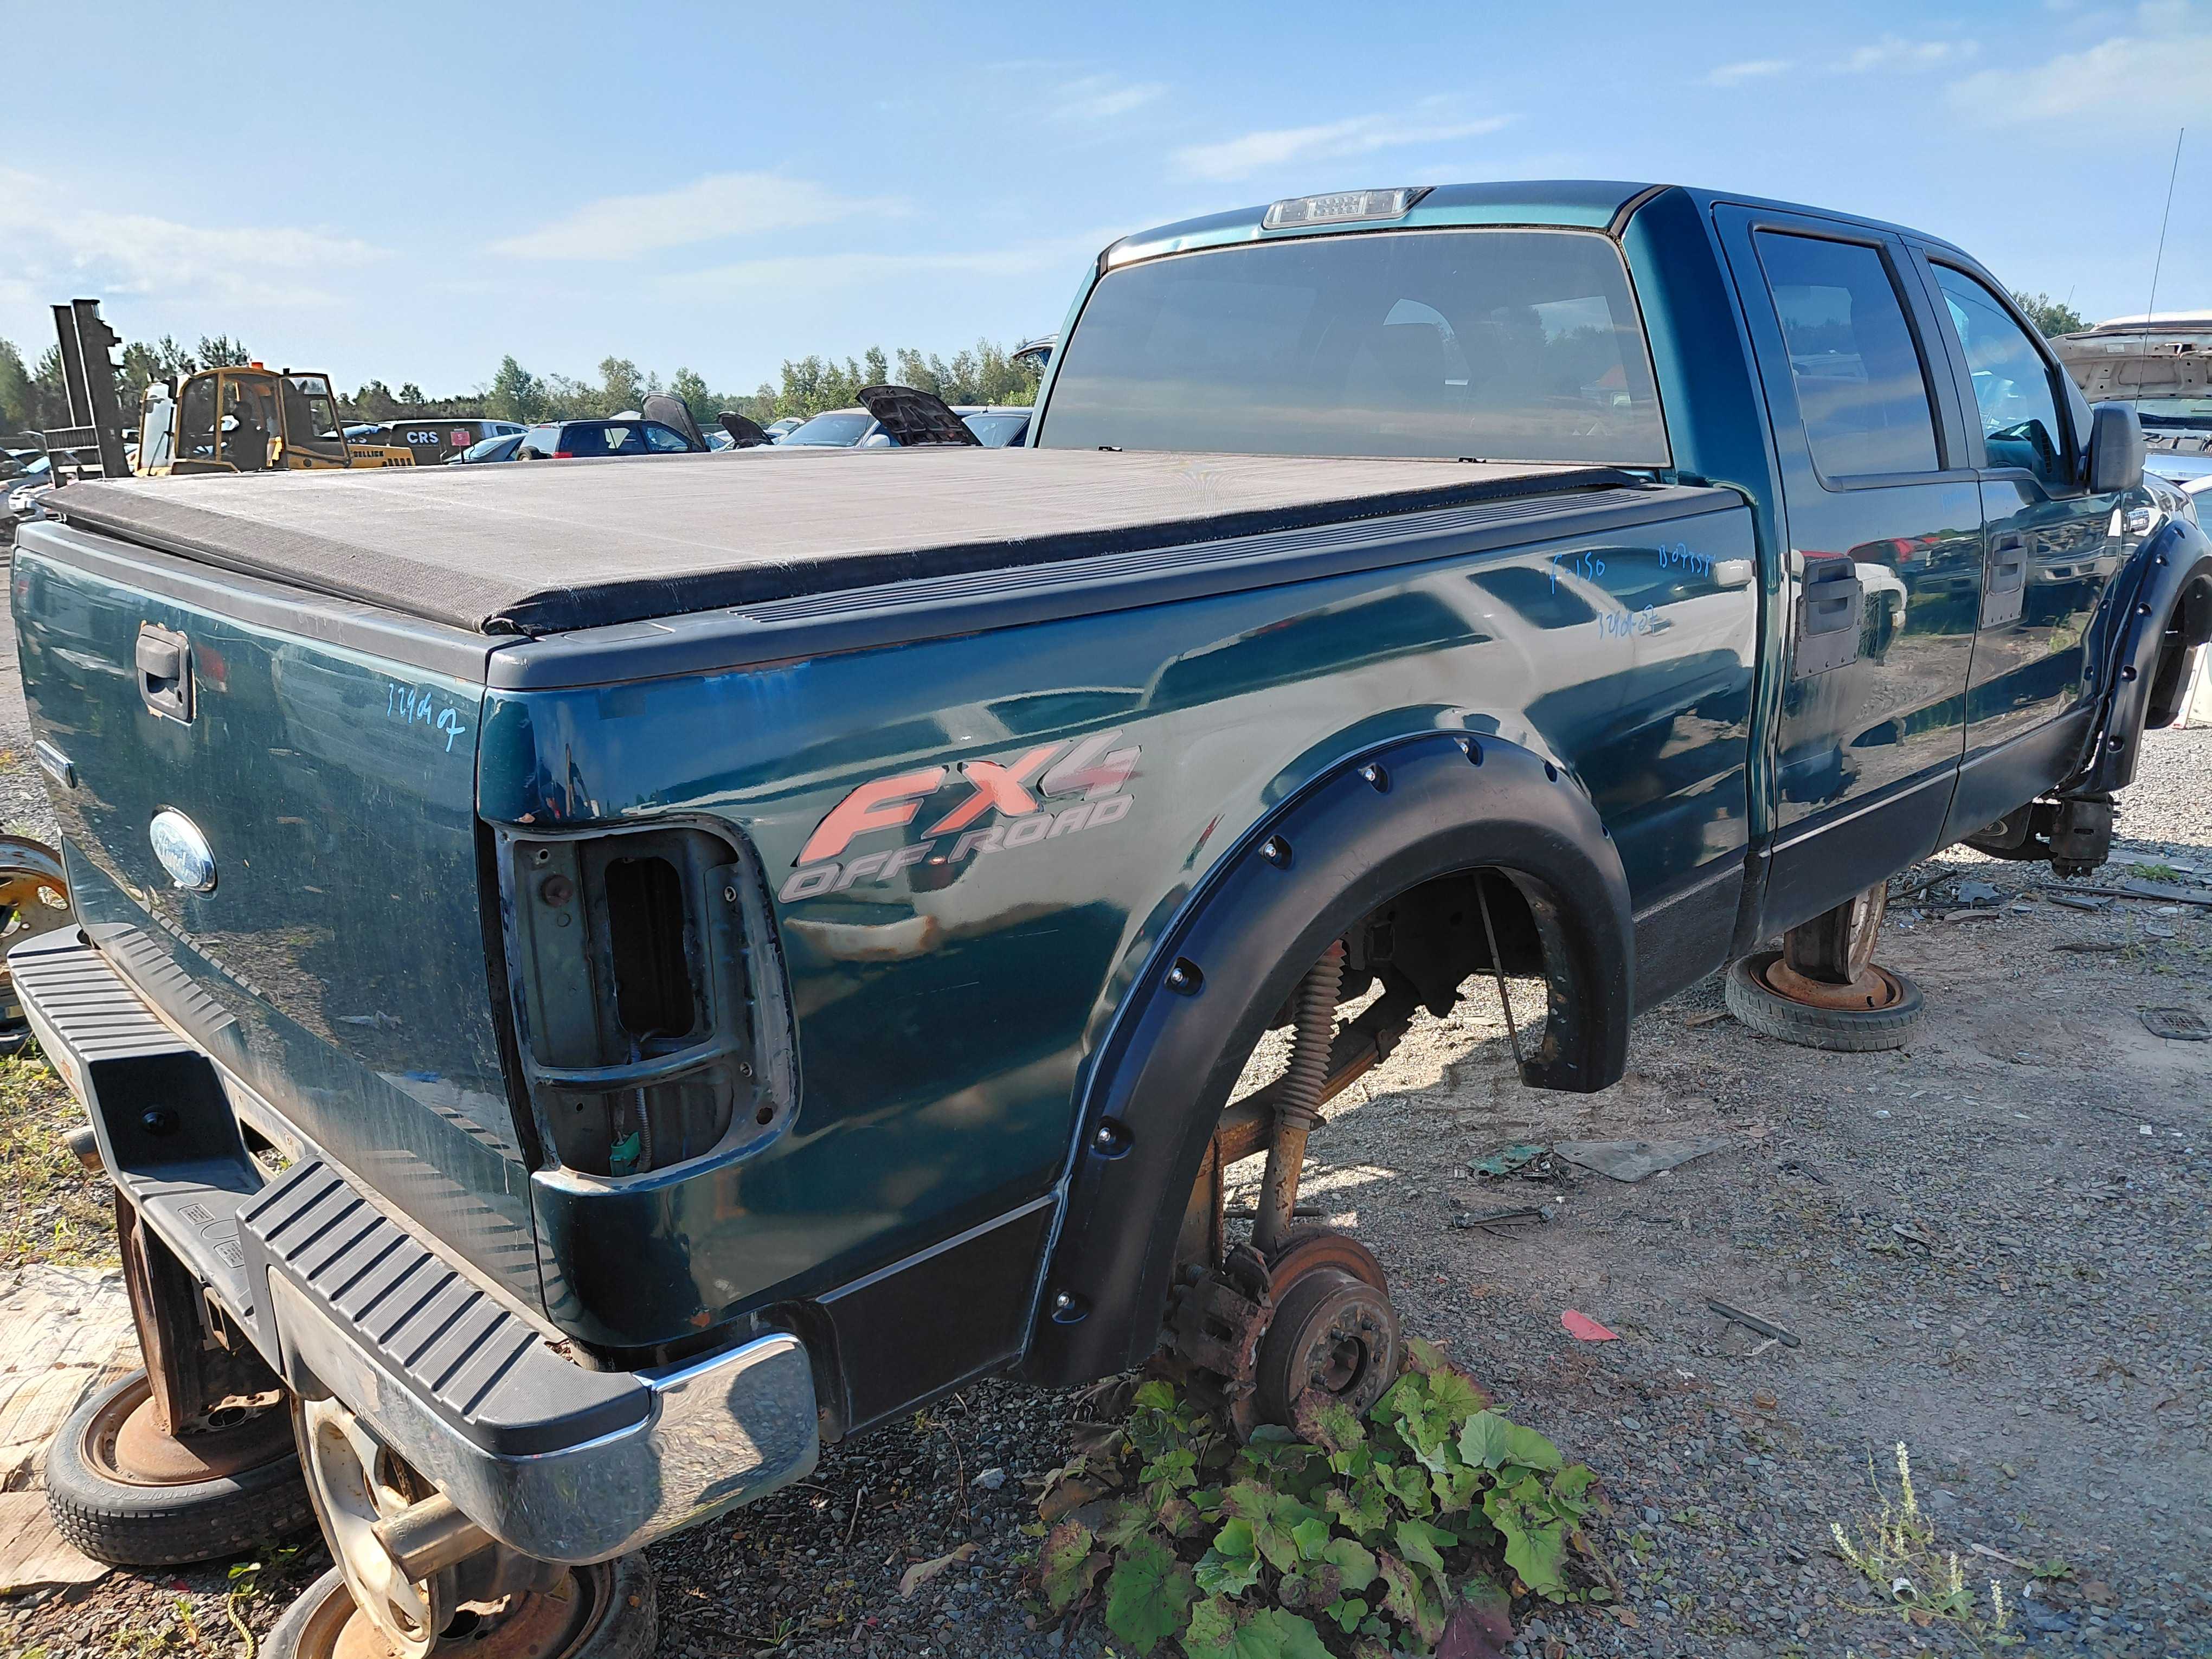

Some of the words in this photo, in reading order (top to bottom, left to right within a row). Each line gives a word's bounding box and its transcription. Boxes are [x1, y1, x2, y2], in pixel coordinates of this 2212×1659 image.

[407, 431, 439, 443] CRS
[1549, 552, 1605, 595] F-150
[790, 729, 1142, 867] FX4
[778, 840, 937, 904] OFF
[947, 794, 1135, 864] ROAD
